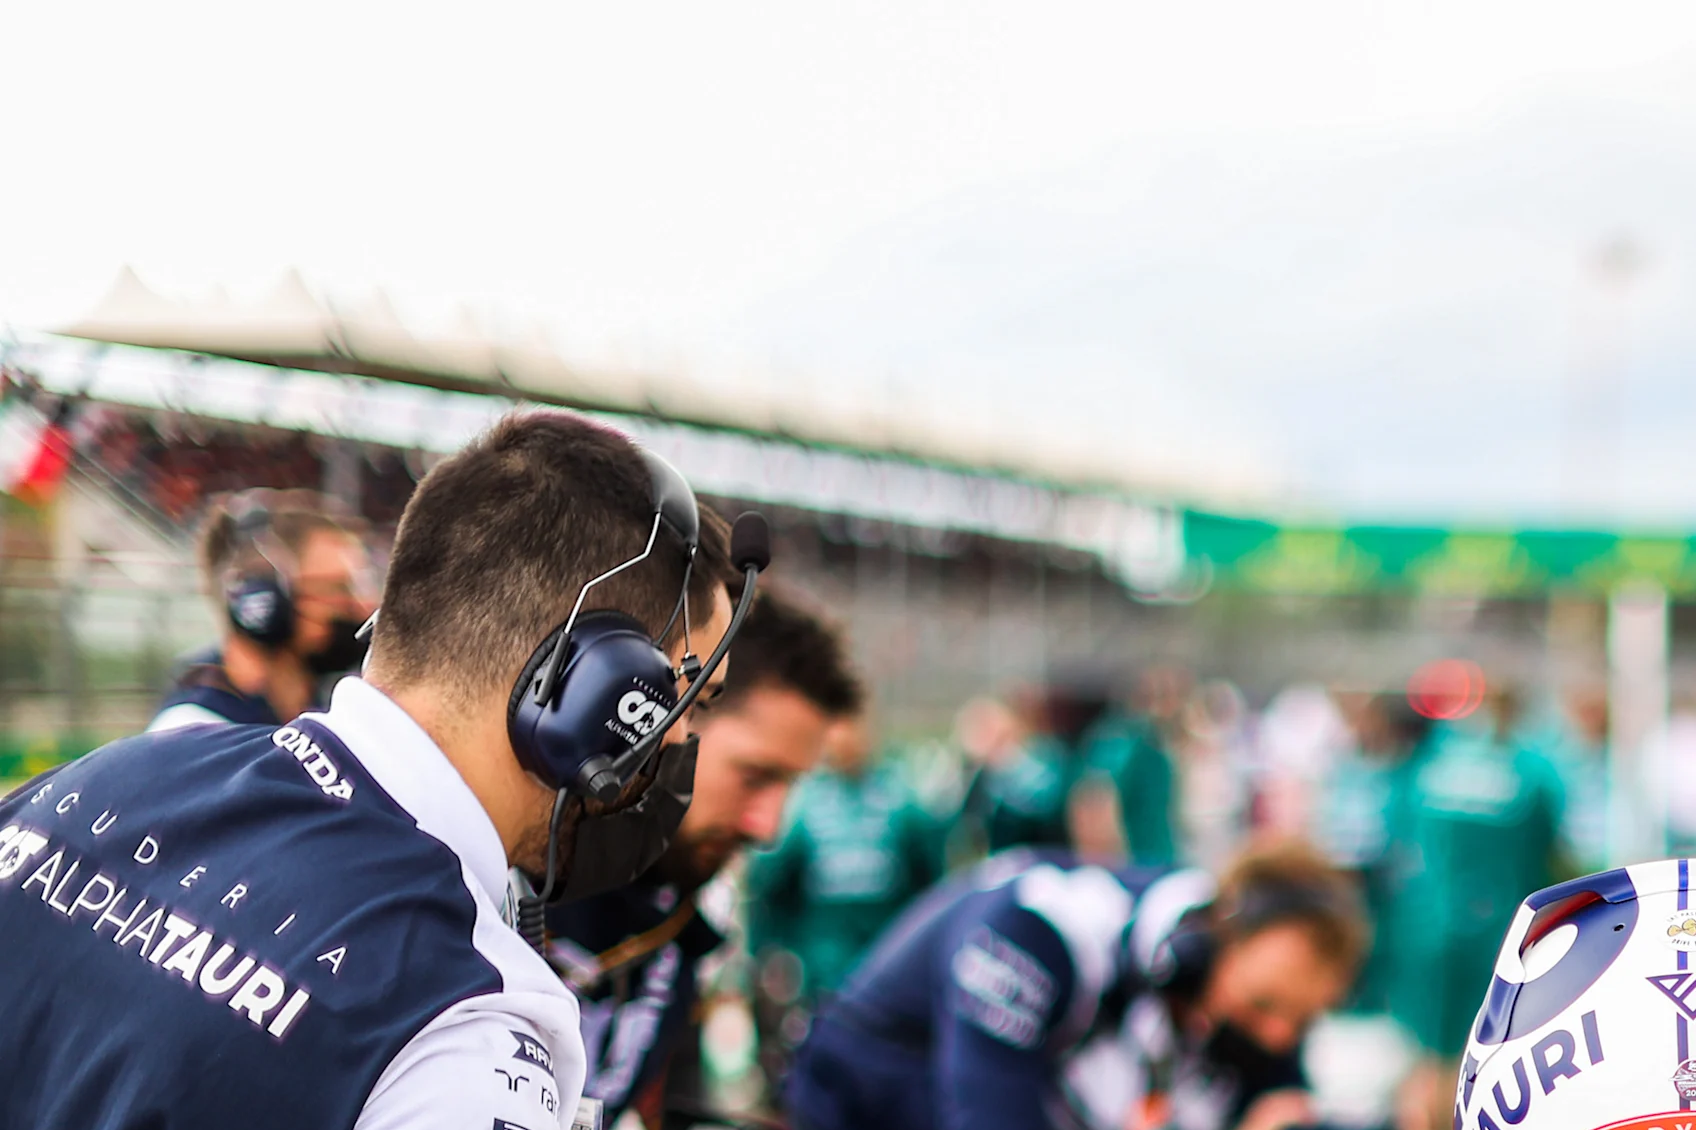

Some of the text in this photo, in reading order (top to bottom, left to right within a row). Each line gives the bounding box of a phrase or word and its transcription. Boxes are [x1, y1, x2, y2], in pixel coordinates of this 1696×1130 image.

[271, 726, 354, 801] ONDA
[20, 848, 311, 1039] ALPHATAURI
[30, 783, 348, 975] SCUDERIA
